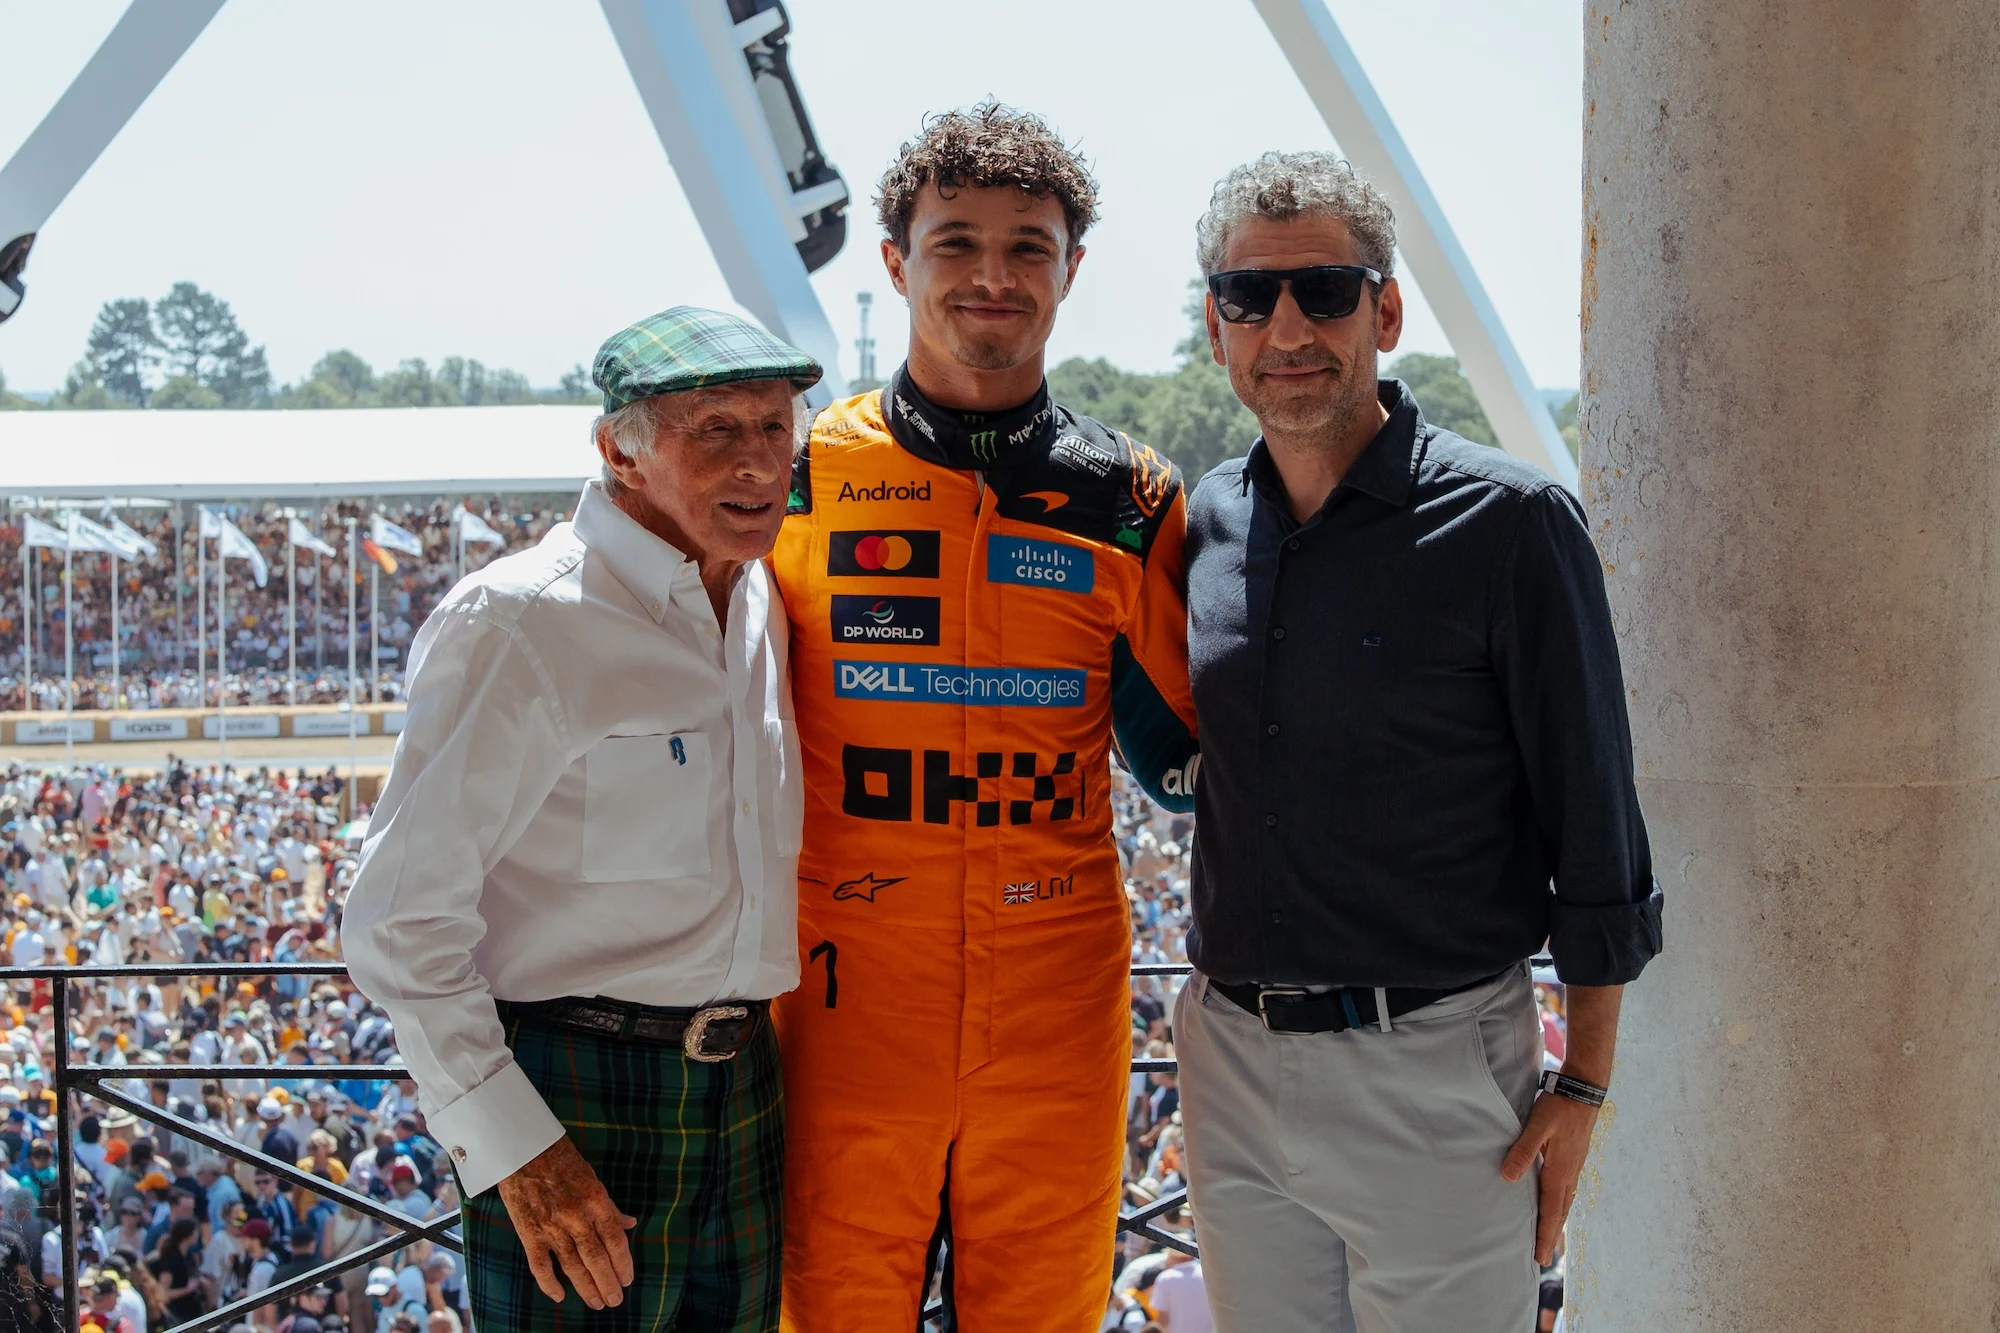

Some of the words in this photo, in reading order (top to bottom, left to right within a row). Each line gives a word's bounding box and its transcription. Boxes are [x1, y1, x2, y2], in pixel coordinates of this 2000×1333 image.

[844, 433, 861, 443] THE
[1061, 437, 1109, 466] Hilton
[1072, 453, 1088, 467] THE
[1088, 463, 1108, 478] STAY
[837, 480, 931, 502] Android
[1016, 565, 1066, 582] CISCO
[843, 625, 864, 638] DP
[865, 626, 924, 639] WORLD
[841, 665, 915, 693] DELL
[920, 668, 1080, 704] Technologies
[809, 939, 838, 1009] 1
